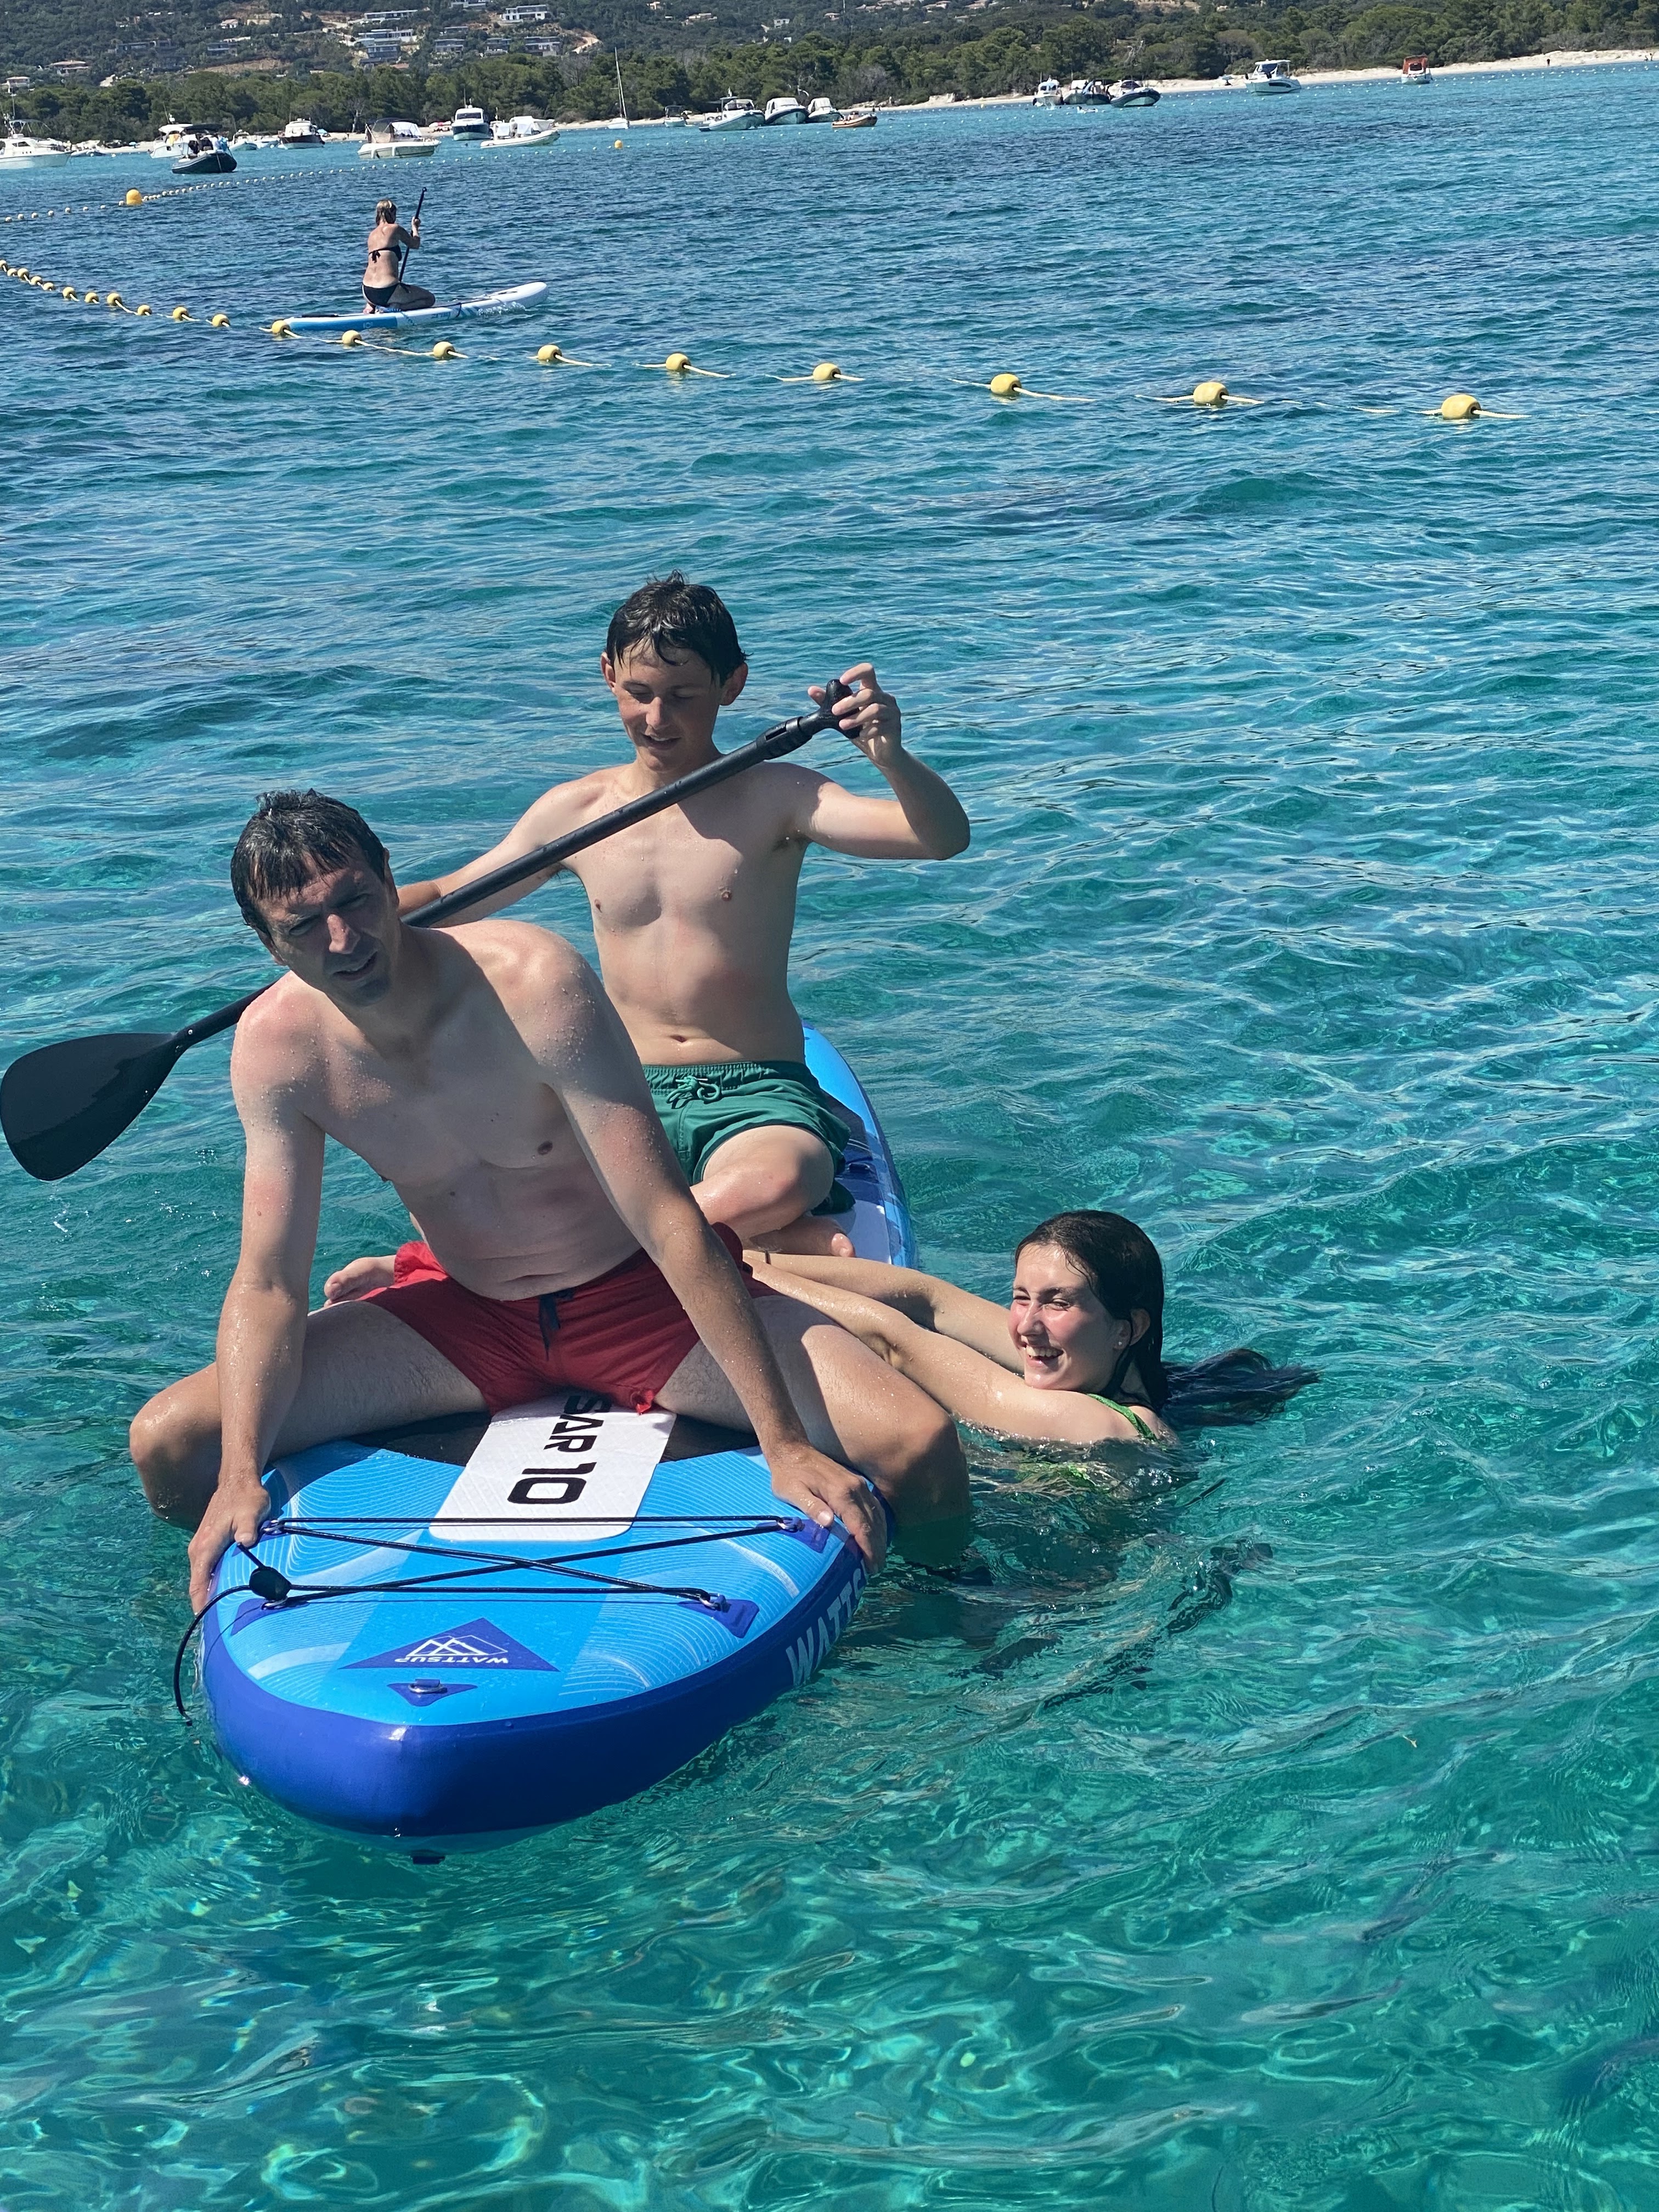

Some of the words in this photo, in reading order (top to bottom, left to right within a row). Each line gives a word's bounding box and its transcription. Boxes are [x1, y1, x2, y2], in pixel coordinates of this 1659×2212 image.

[543, 1395, 612, 1453] SAR
[507, 1462, 597, 1504] 10
[394, 1655, 509, 1664] WATTSUP
